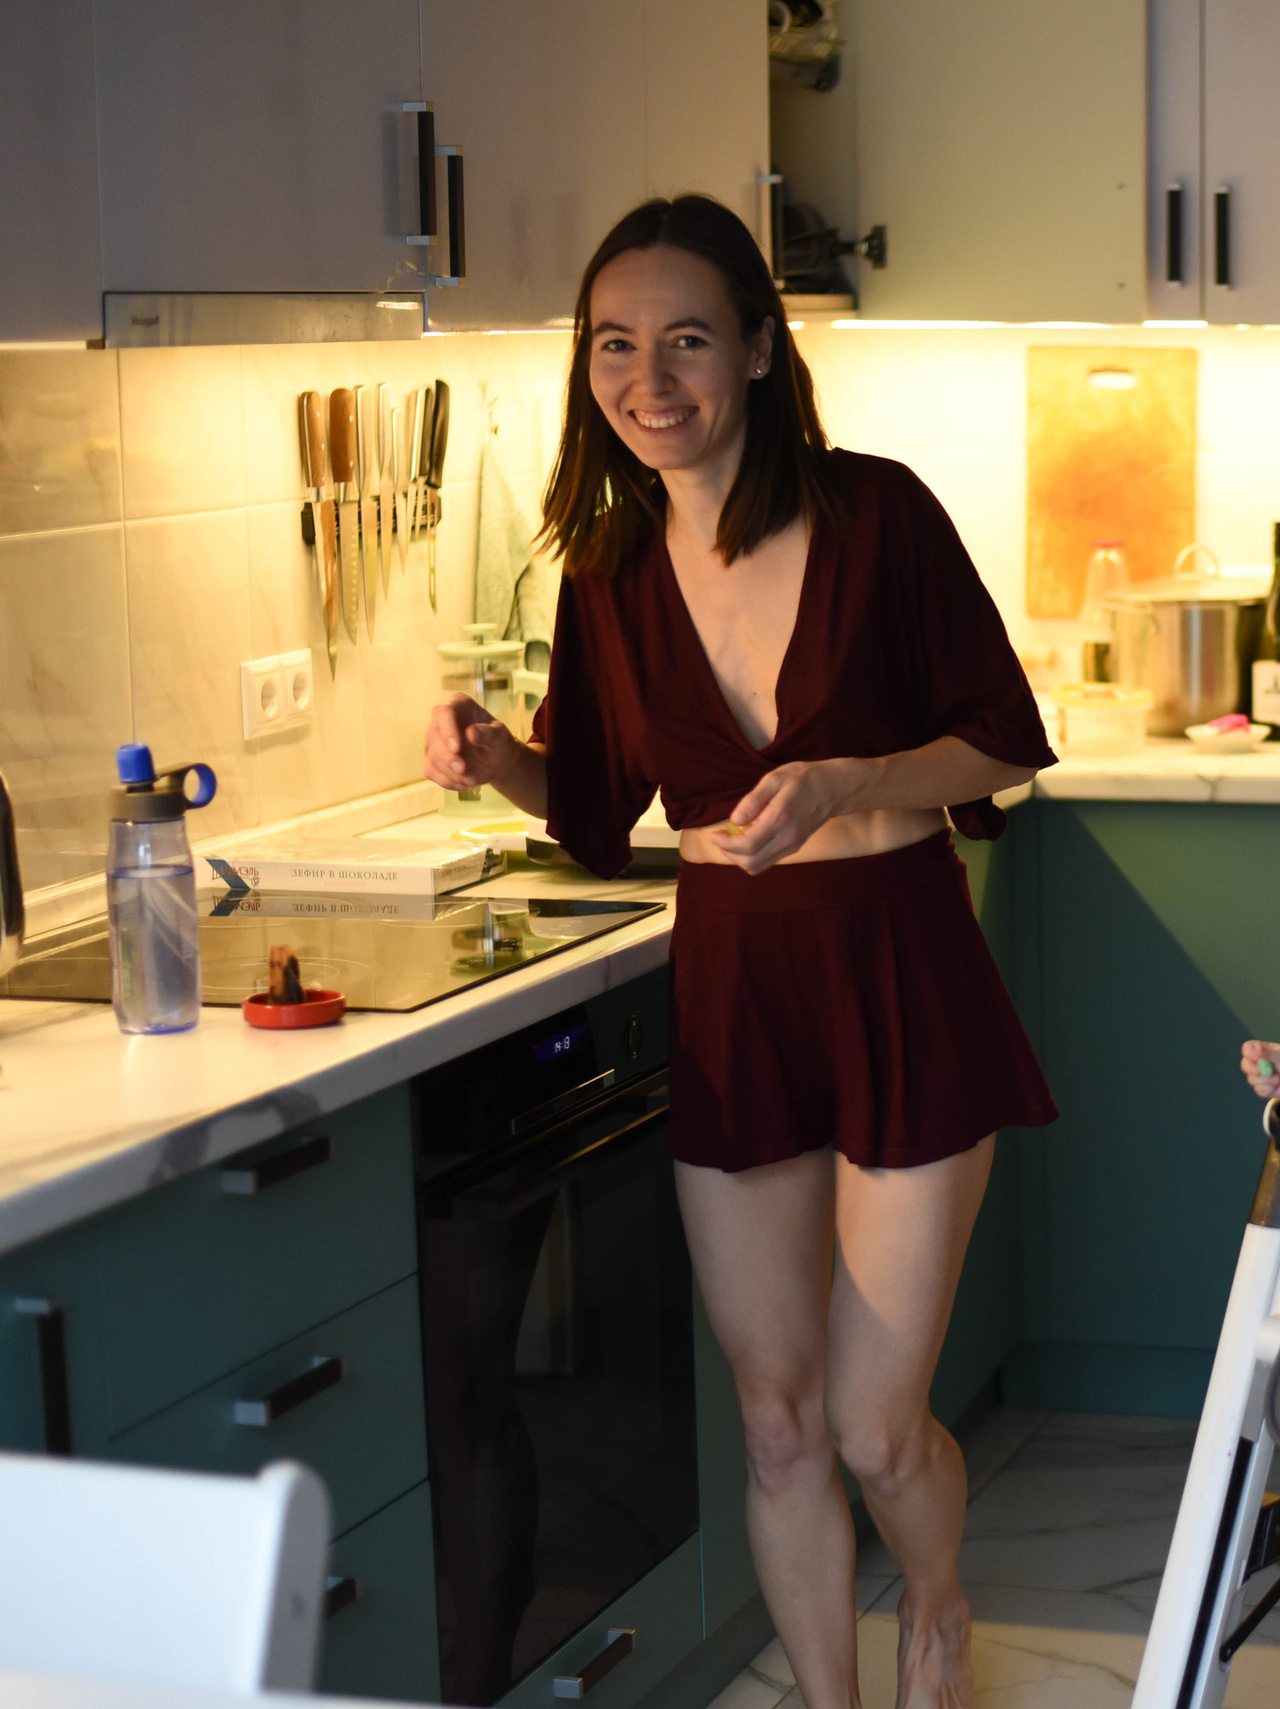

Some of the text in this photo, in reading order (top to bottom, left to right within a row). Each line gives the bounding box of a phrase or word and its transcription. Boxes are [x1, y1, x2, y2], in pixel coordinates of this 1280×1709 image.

[291, 869, 399, 881] ЗЕФИР В ШОКОЛАДЕ
